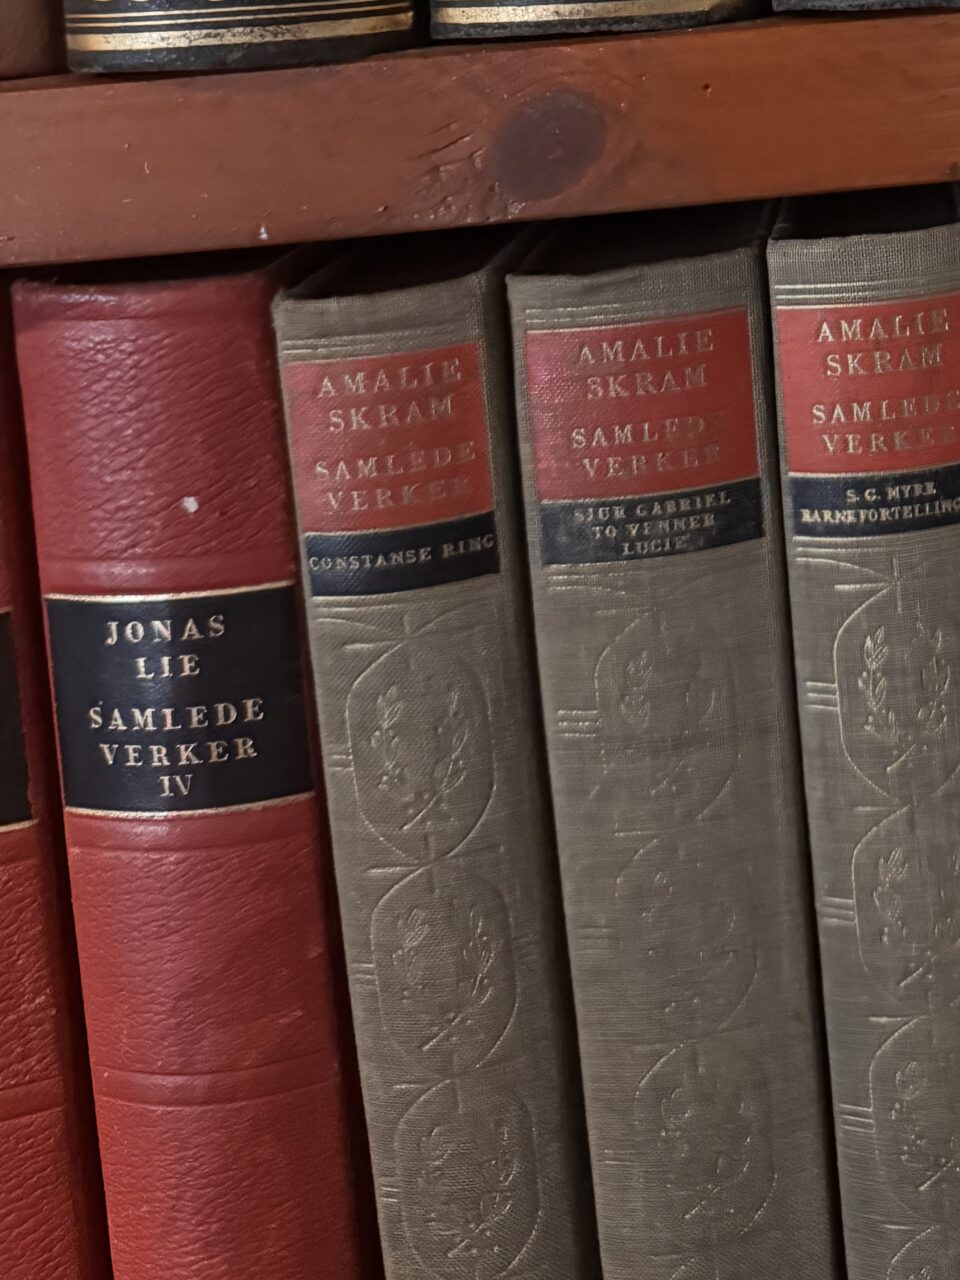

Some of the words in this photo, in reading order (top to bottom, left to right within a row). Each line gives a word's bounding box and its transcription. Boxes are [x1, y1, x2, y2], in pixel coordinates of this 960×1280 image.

[817, 308, 950, 343] AMALIE
[577, 328, 714, 365] AMALIE
[826, 343, 943, 377] SKRAM
[317, 357, 463, 398] AMALIE
[587, 364, 707, 400] SKRAM
[328, 394, 455, 433] SKRAM
[571, 413, 724, 449] SAMLED
[315, 441, 476, 482] SAMLEDE
[325, 478, 470, 511] VERKER
[636, 491, 731, 517] GABRIEL
[442, 533, 495, 559] RING
[591, 525, 617, 540] TO
[105, 614, 226, 646] JONAS
[135, 654, 200, 679] LIE
[88, 697, 265, 732] SAMLEDE
[99, 737, 257, 767] VERKER
[159, 774, 193, 797] IV
